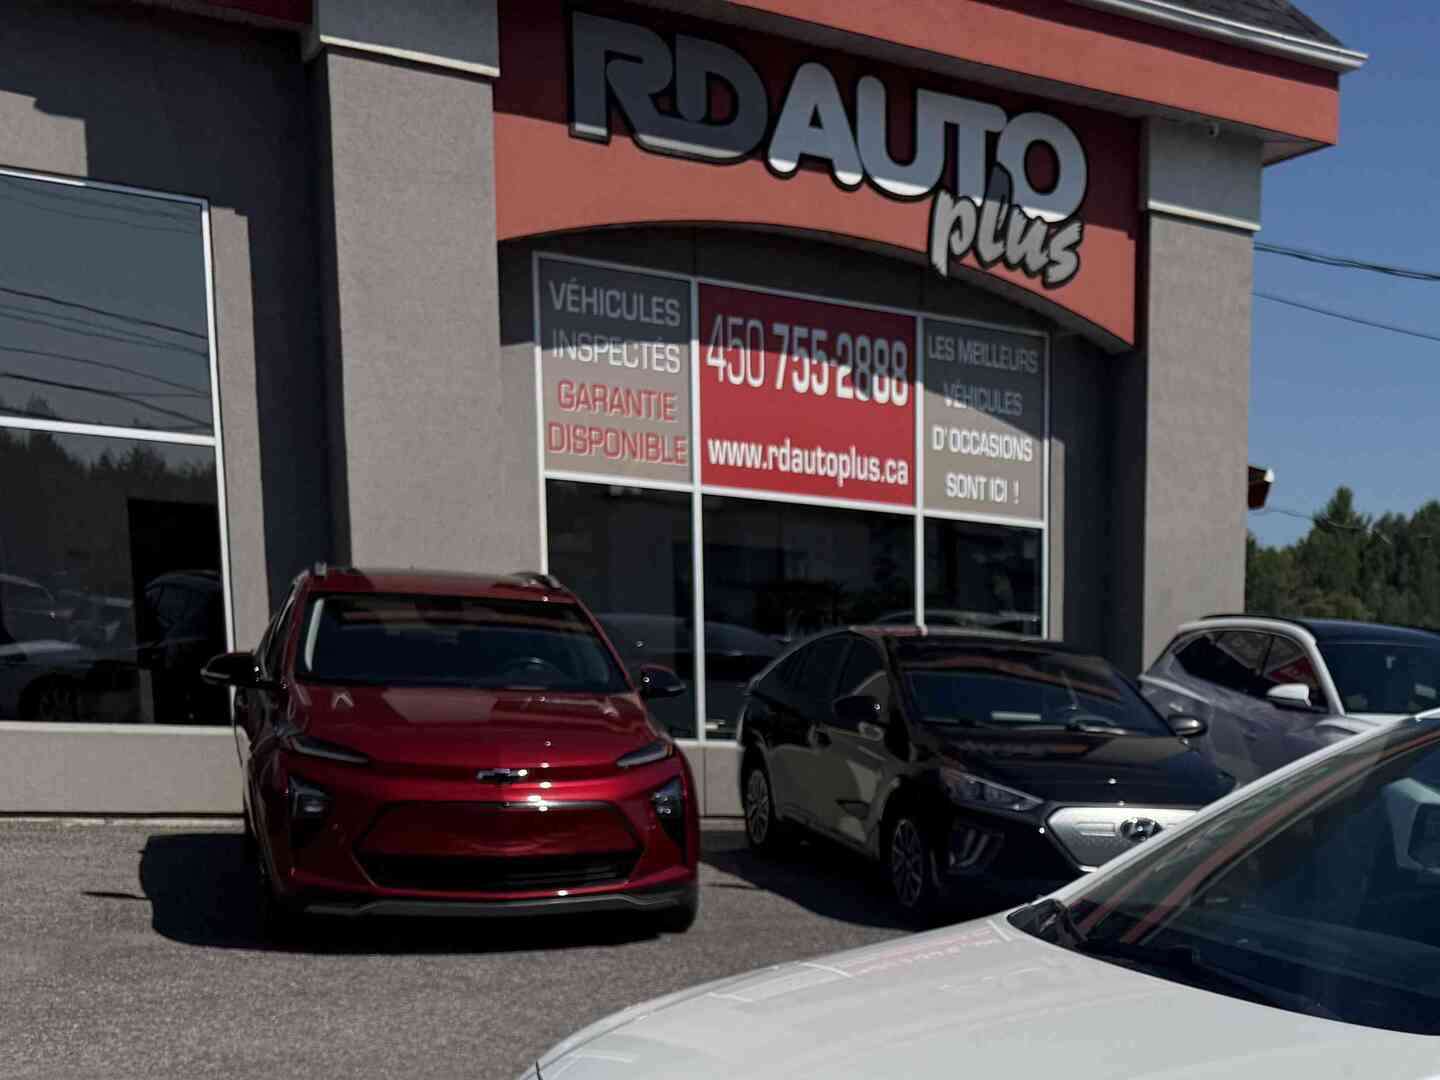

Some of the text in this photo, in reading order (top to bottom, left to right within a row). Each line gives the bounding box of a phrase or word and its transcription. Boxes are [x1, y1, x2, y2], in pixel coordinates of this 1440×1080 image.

[930, 162, 1083, 284] plus
[549, 277, 681, 327] VÉHICULES
[551, 329, 681, 373] INSPECTÉS
[706, 314, 766, 388] 450
[928, 335, 1039, 374] LES MEILLEURS
[558, 379, 679, 423] GARANTIE
[943, 379, 1023, 417] VÉHICULES
[548, 421, 689, 466] DISPONIBLE
[707, 437, 909, 487] www.rdautoplus.ca
[945, 473, 987, 500] SONT
[991, 479, 1008, 502] ICI
